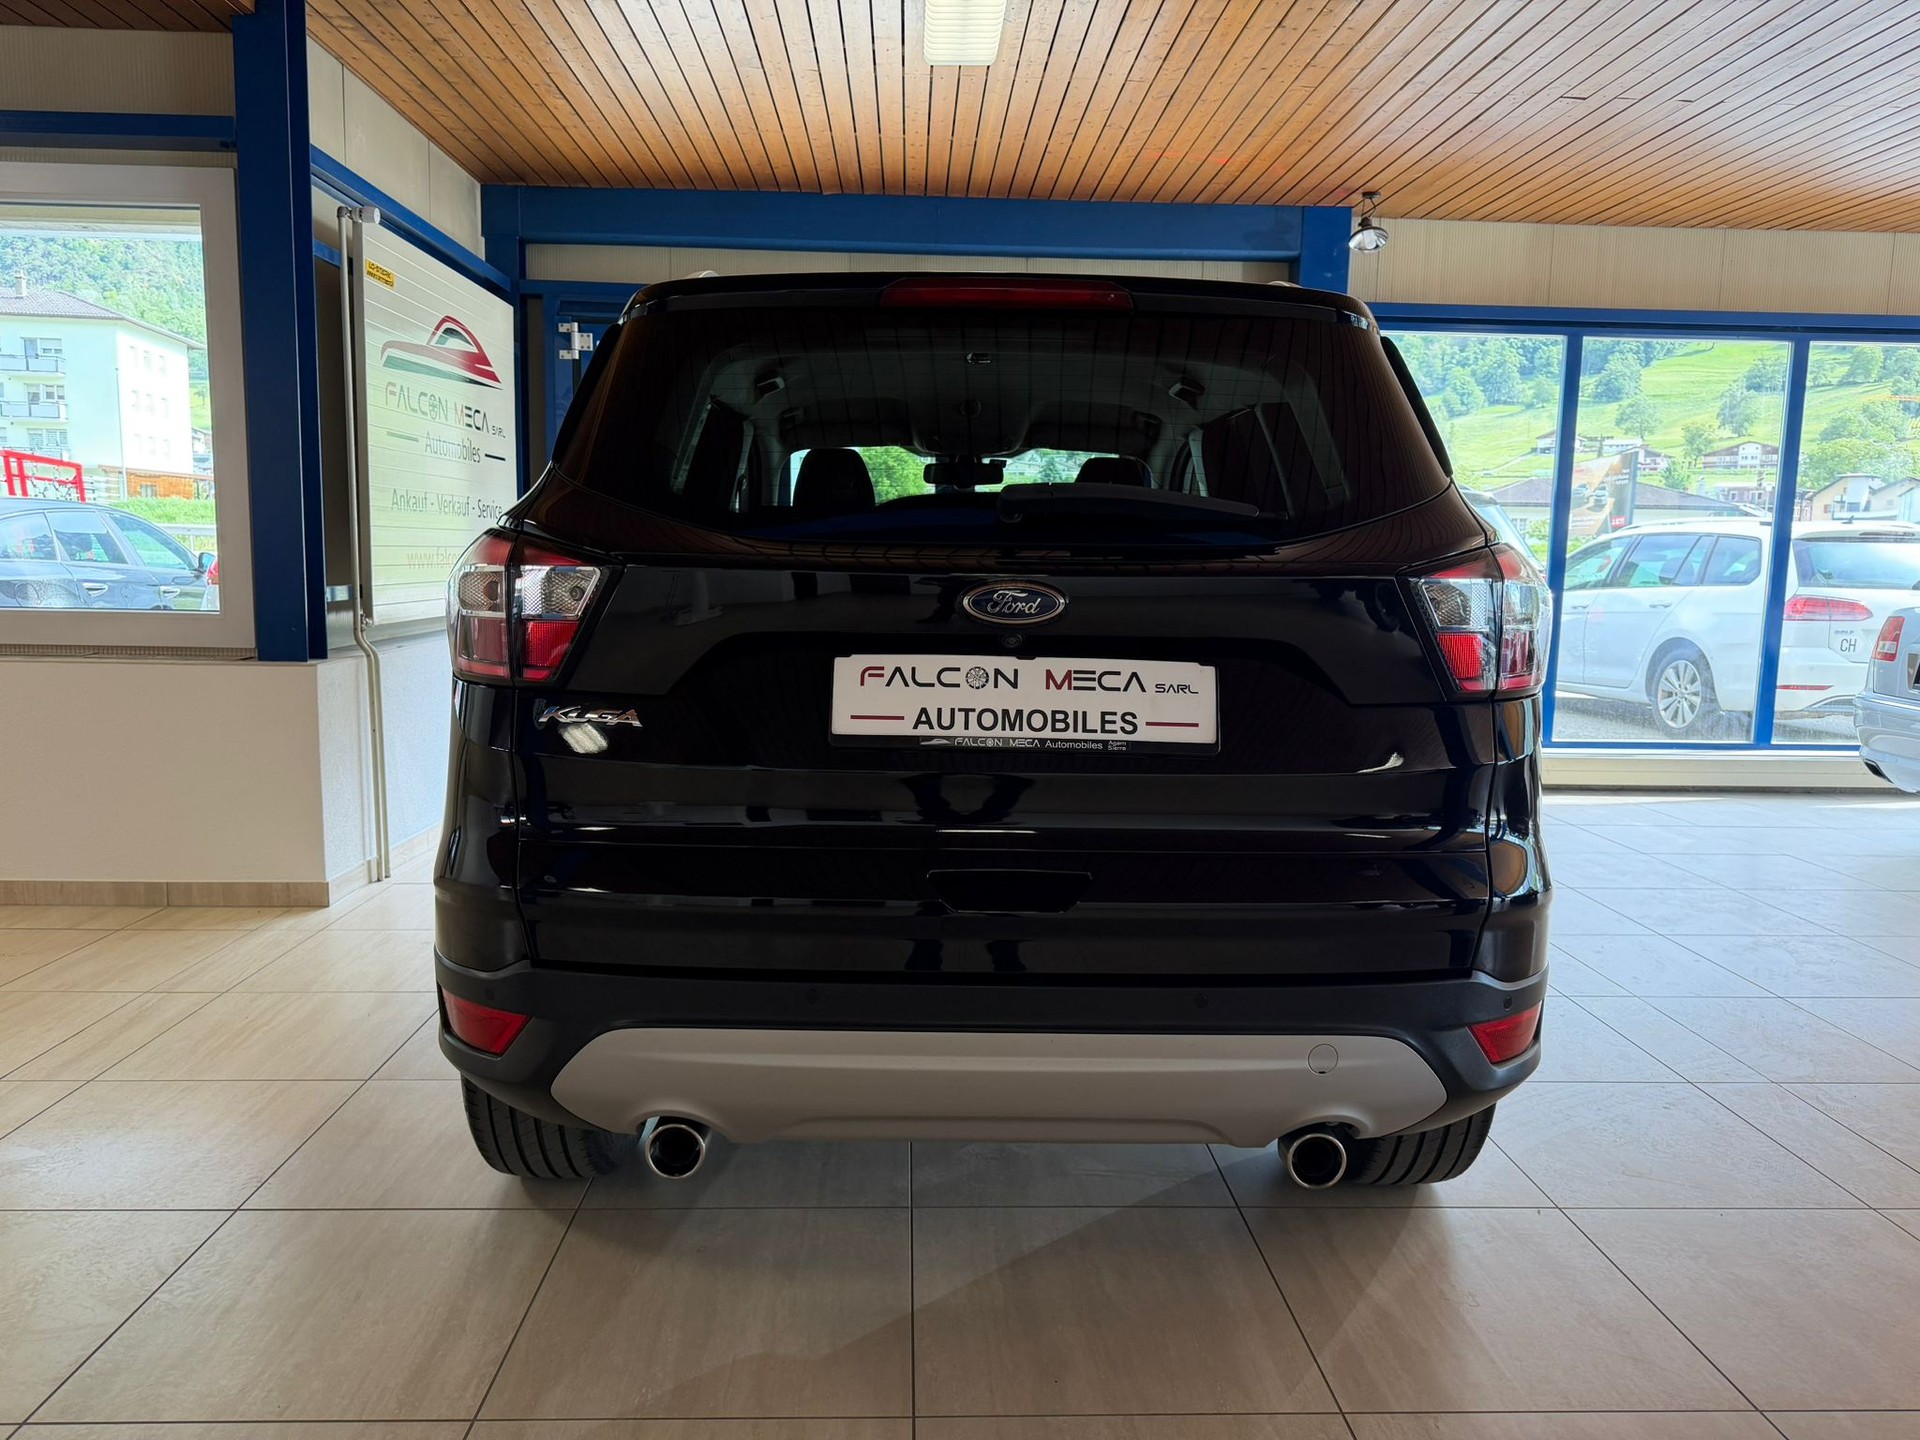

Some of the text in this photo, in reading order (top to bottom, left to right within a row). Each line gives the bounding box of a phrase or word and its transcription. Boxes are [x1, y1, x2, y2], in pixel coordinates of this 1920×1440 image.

[385, 381, 448, 422] FALCON
[454, 402, 489, 434] MECA
[425, 431, 480, 463] Automobiles
[391, 488, 428, 513] Ankauf
[436, 493, 470, 517] Verkauf
[477, 499, 502, 520] Service
[986, 590, 1042, 615] Ford
[1840, 638, 1857, 653] CH
[860, 665, 1200, 695] FALCON MECA SARL
[911, 706, 1139, 736] AUTOMOBILES
[954, 738, 1104, 750] FALCON MECA Automobiles
